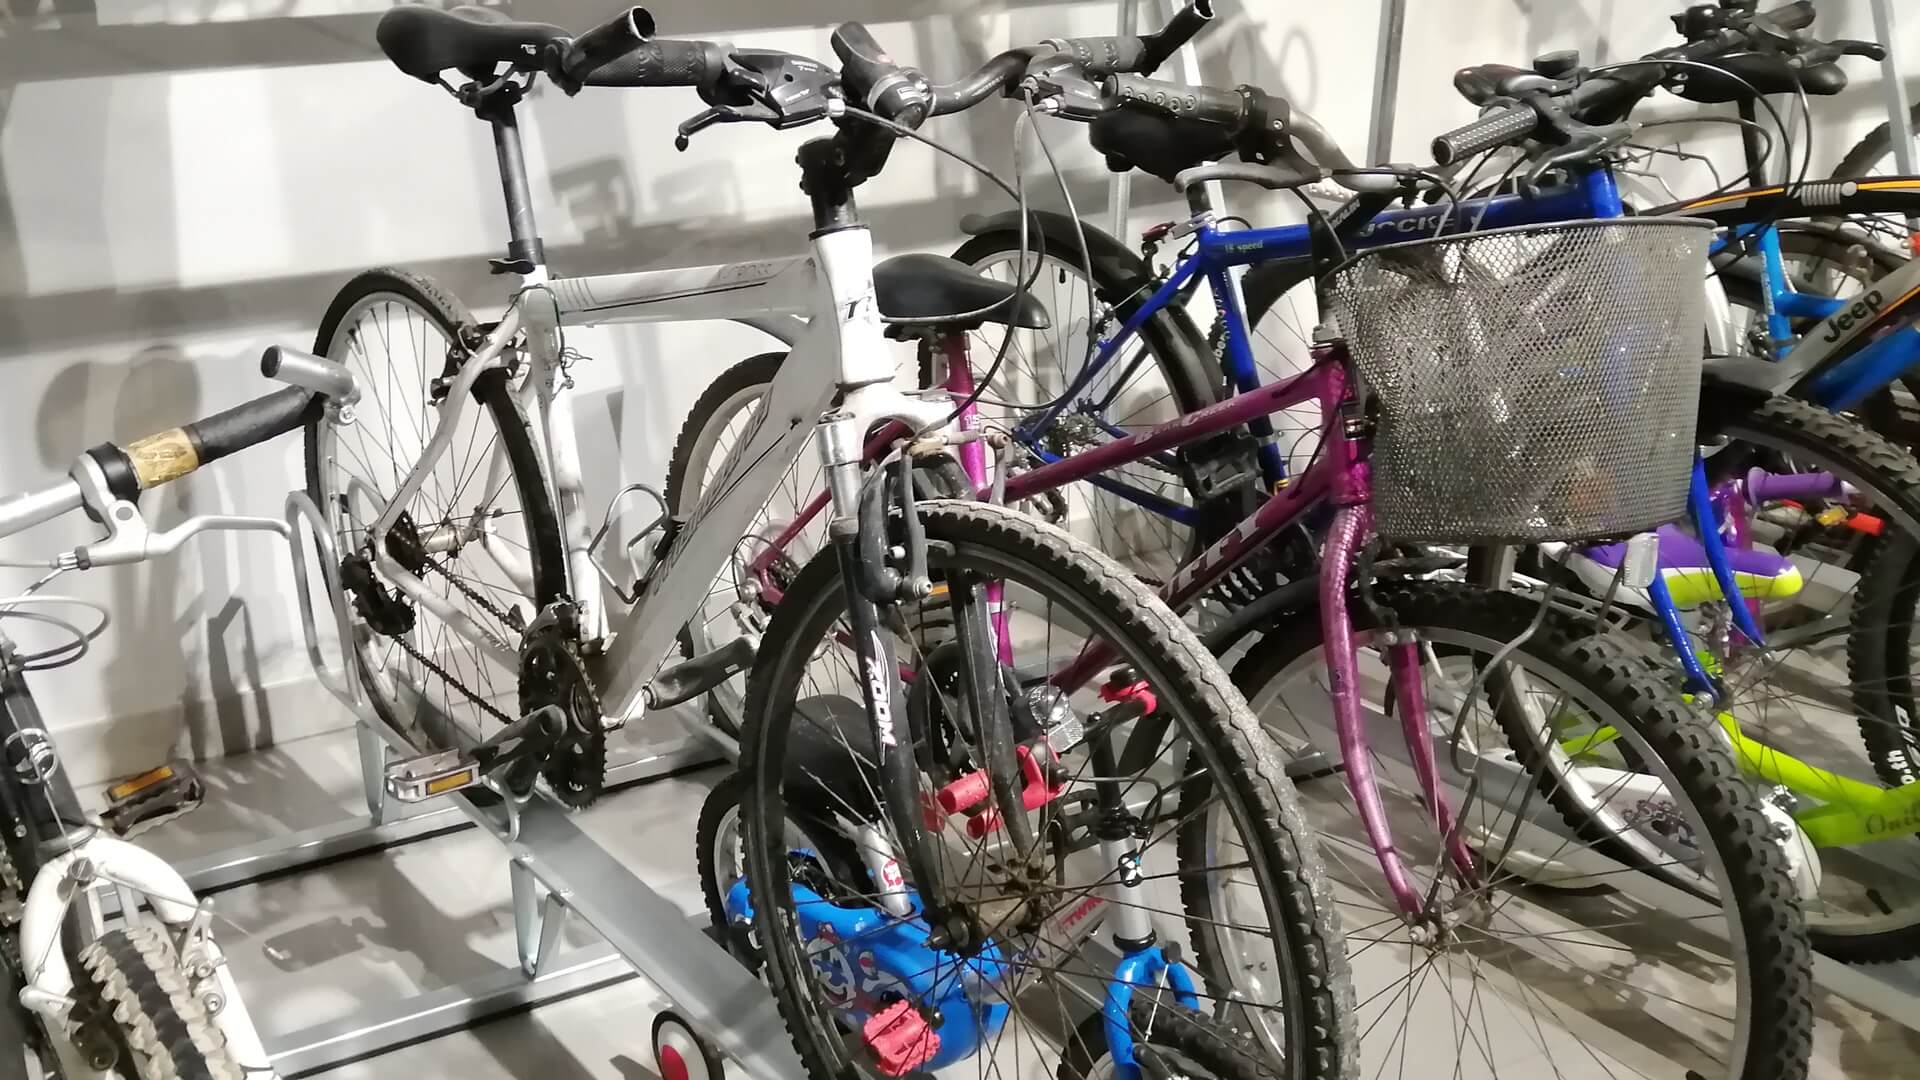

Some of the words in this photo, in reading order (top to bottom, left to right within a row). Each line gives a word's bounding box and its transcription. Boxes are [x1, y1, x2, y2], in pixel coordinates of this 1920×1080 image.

[1236, 239, 1264, 254] speed
[1823, 290, 1883, 342] Jeep
[865, 655, 897, 747] ZOOM
